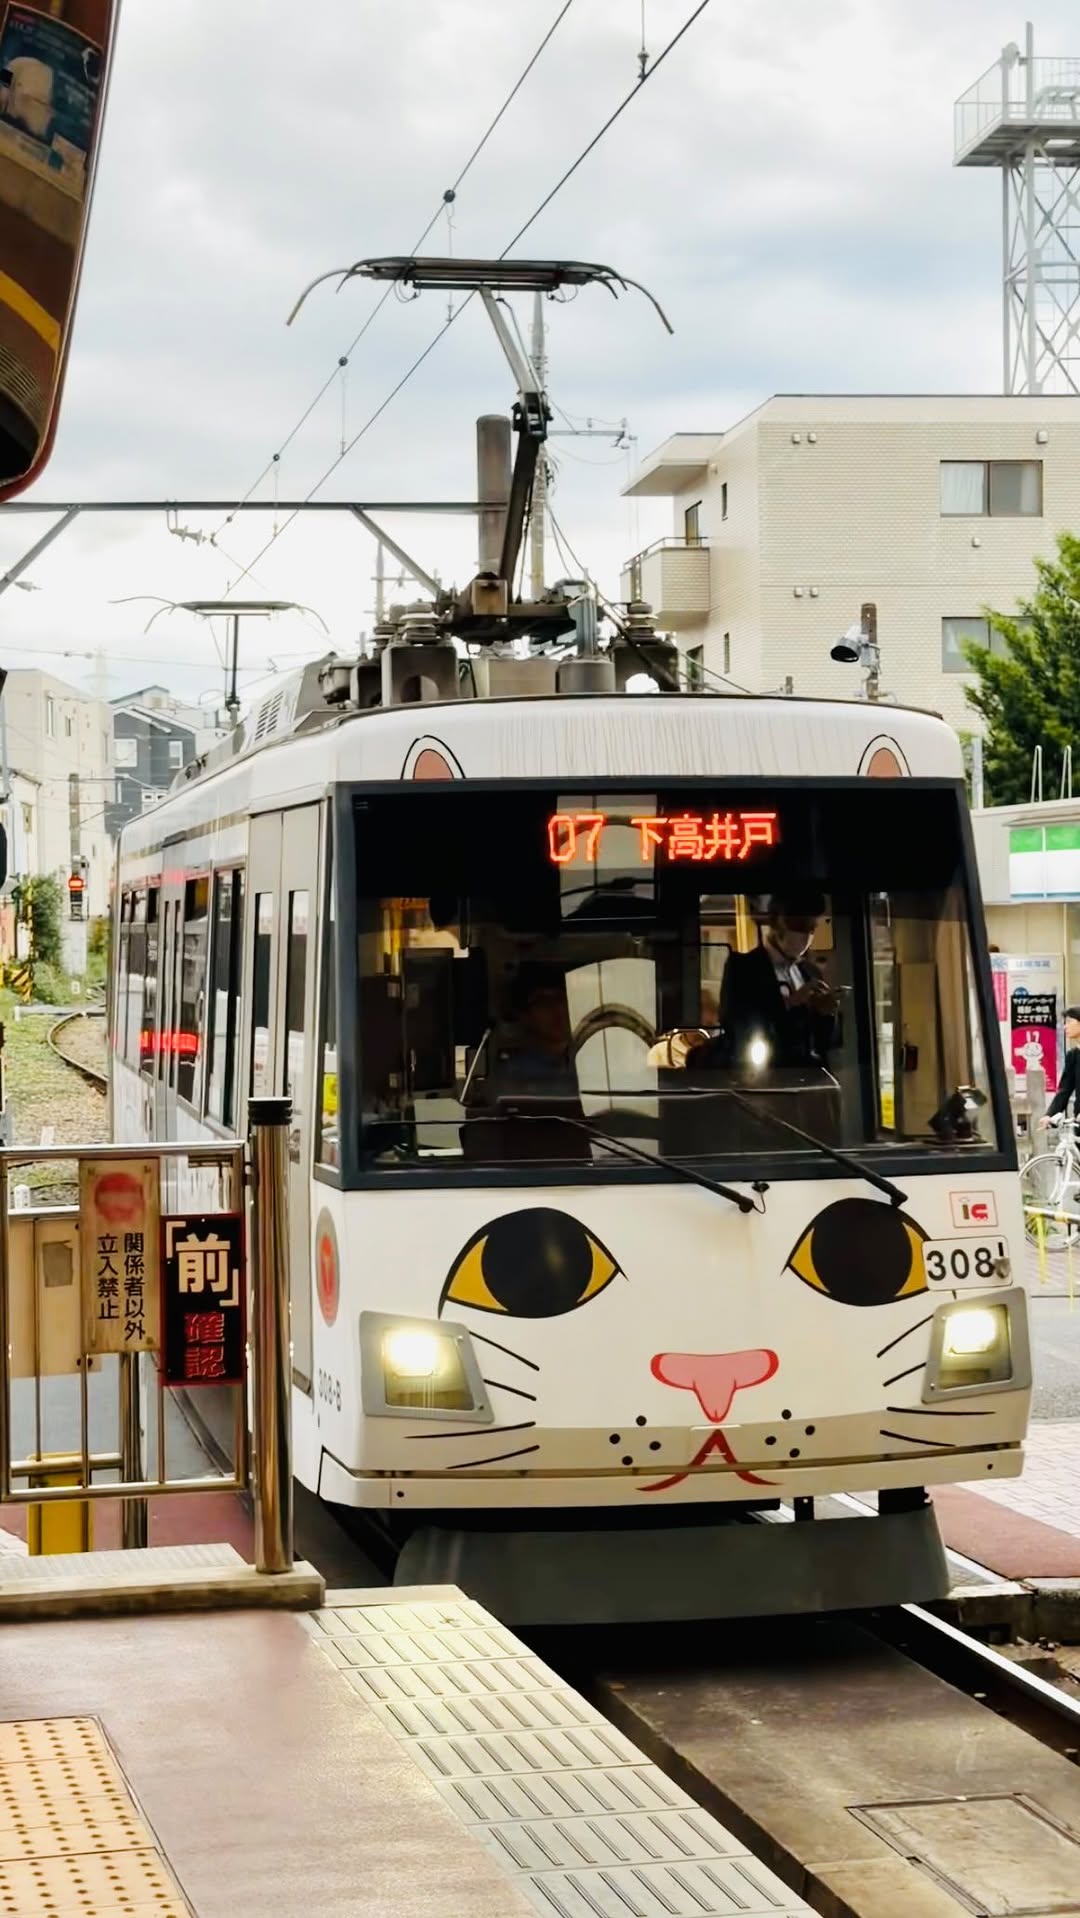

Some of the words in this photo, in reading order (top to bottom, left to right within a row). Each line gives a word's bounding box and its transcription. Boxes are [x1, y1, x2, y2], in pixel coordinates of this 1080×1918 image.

[548, 814, 604, 861] 07
[631, 813, 776, 860] 下高井戸
[97, 1232, 120, 1321] 立入禁止
[123, 1232, 147, 1342] 関係者以外
[184, 1312, 227, 1378] 確認
